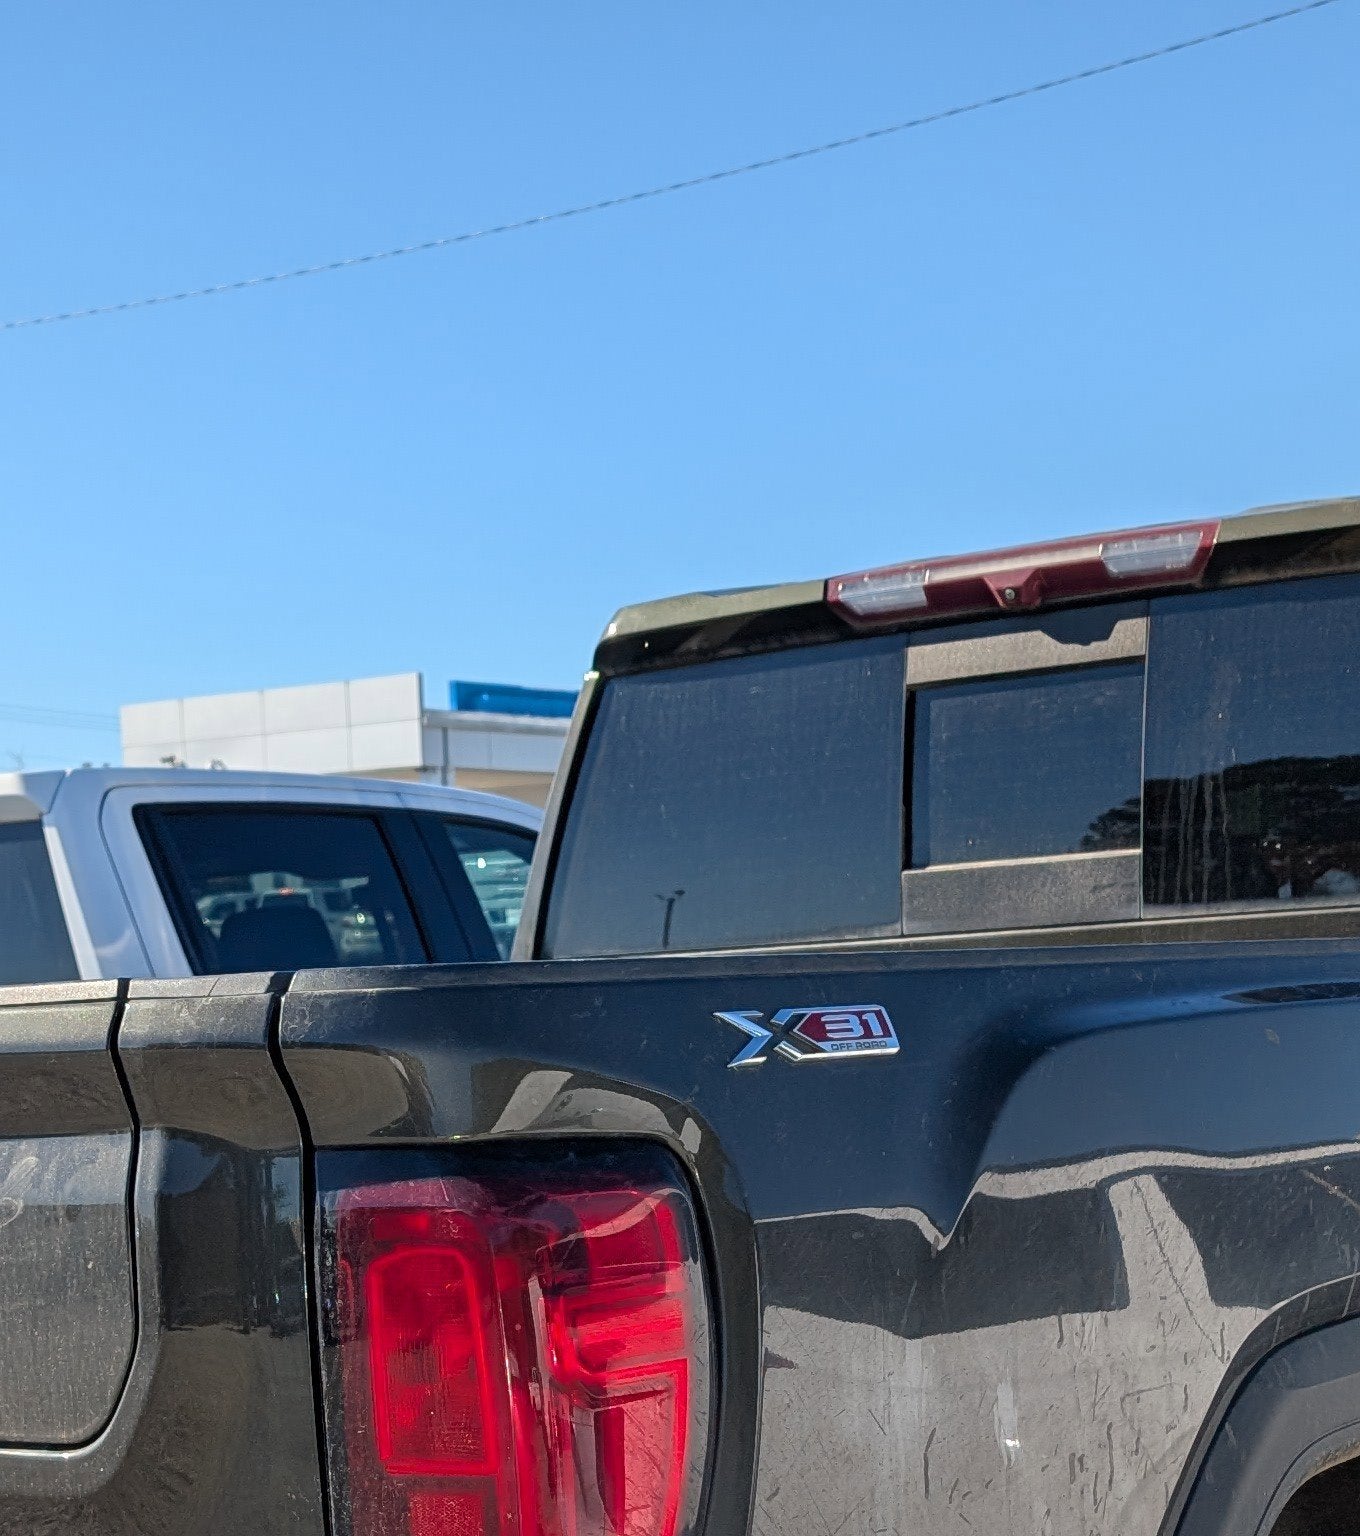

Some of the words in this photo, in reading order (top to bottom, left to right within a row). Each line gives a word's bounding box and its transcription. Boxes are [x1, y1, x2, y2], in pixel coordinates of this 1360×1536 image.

[712, 1003, 901, 1068] X31
[830, 1042, 854, 1051] OFF
[855, 1040, 888, 1050] ROAD
